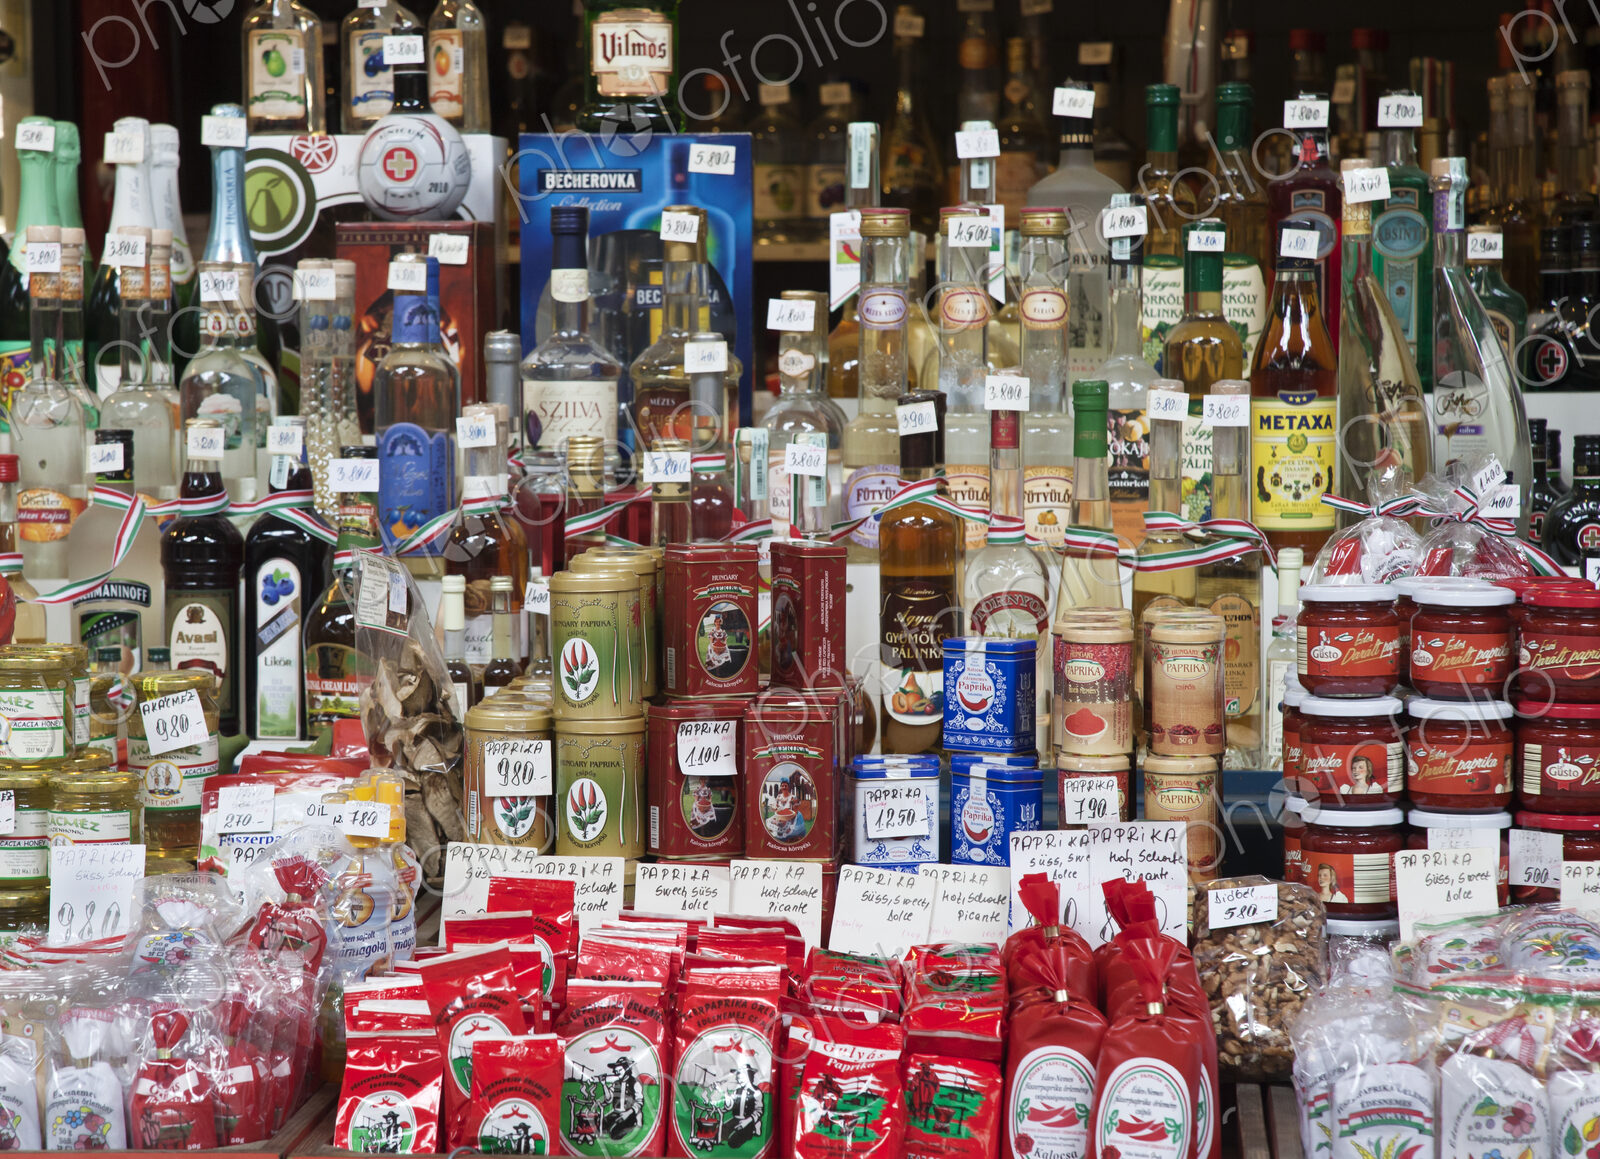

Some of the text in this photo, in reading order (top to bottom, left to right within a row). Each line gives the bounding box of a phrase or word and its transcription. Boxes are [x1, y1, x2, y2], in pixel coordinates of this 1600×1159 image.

[597, 29, 666, 64] Vilmos
[426, 181, 449, 194] 2010
[544, 172, 637, 190] BECHEROVKA
[224, 168, 236, 225] HUNGARIA
[1143, 308, 1184, 320] ÁLINKA
[538, 400, 603, 420] SZILVA
[1258, 414, 1334, 432] METAXA
[1109, 440, 1150, 456] OKAJI
[175, 630, 218, 644] Avasi
[1066, 664, 1101, 676] PAPRIKA
[1166, 662, 1207, 673] PAPRIKA
[958, 680, 993, 692] Paprika
[13, 718, 62, 728] ACACIA HONEY
[679, 721, 731, 737] PAPRIKA
[485, 740, 544, 756] PAPRIKA
[589, 760, 621, 769] PAPRIKA
[1453, 752, 1499, 777] paprika
[866, 787, 922, 803] PAPRIKA
[1065, 779, 1115, 795] PAPRIKA
[1159, 793, 1201, 804] PAPRIKA
[963, 809, 993, 823] Paprika
[24, 838, 47, 847] HONEY
[1010, 832, 1090, 851] PAPRIKA
[1089, 827, 1178, 843] PAPRIKA
[56, 850, 134, 866] PAPRIKA
[449, 845, 536, 864] PAPRIKA
[1400, 851, 1473, 869] PAPRIKA
[640, 866, 710, 881] PAPRIKA
[732, 865, 806, 880] PAPRIKA
[841, 868, 917, 888] PAPRIKA
[576, 898, 609, 913] icante
[57, 901, 121, 944] 980
[826, 1057, 877, 1073] Paprika
